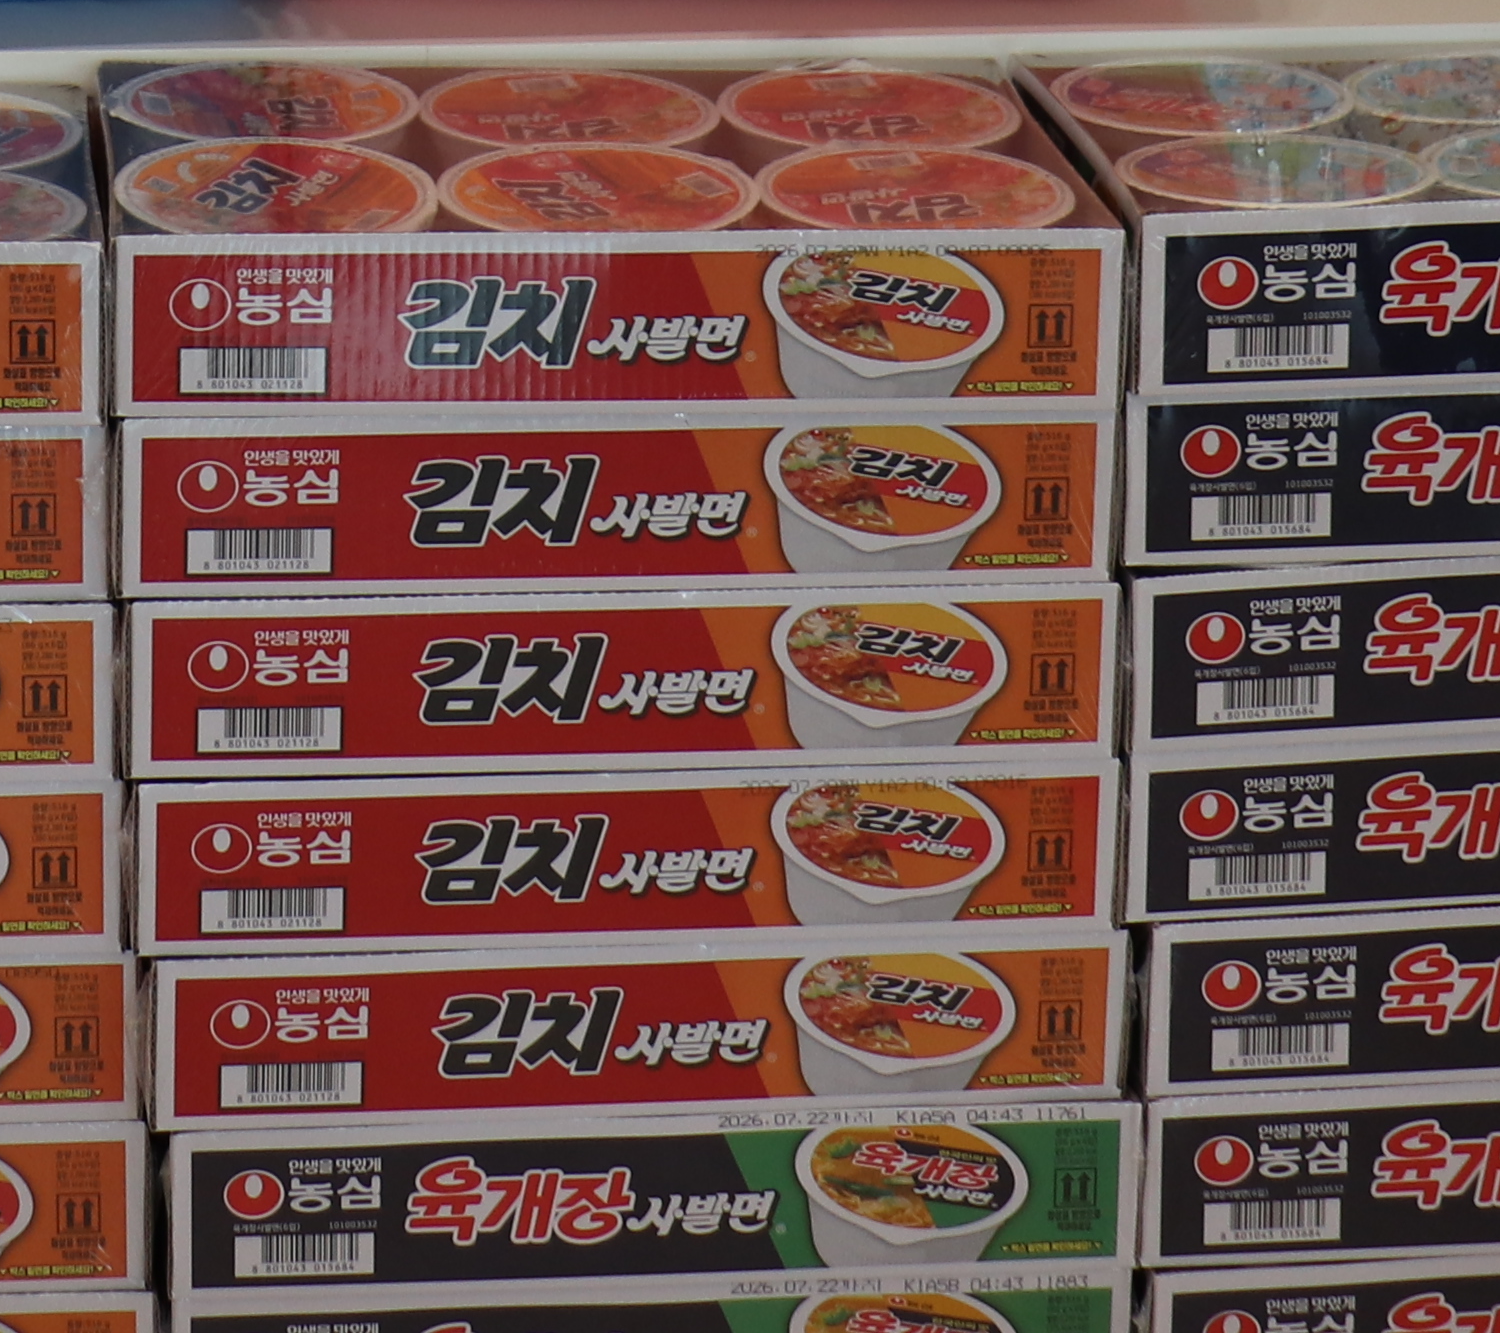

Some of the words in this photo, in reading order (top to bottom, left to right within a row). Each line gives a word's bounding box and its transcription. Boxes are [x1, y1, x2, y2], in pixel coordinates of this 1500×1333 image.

[192, 156, 307, 215] 김치
[1262, 243, 1308, 261] 인생을
[1310, 241, 1357, 259] 맛있게
[238, 267, 283, 283] 인생을
[286, 267, 334, 283] 맛있게
[1261, 261, 1355, 301] 농심
[236, 286, 332, 324] 농심
[397, 275, 597, 369] 김치
[587, 316, 744, 360] 사발면
[1247, 614, 1340, 654] 농심
[414, 814, 609, 904] 김치
[599, 848, 752, 893] 사발면
[1264, 963, 1355, 1002] 농심
[287, 1175, 380, 1212] 농심
[404, 1155, 635, 1245] 육개장
[626, 1191, 776, 1235] 사발면
